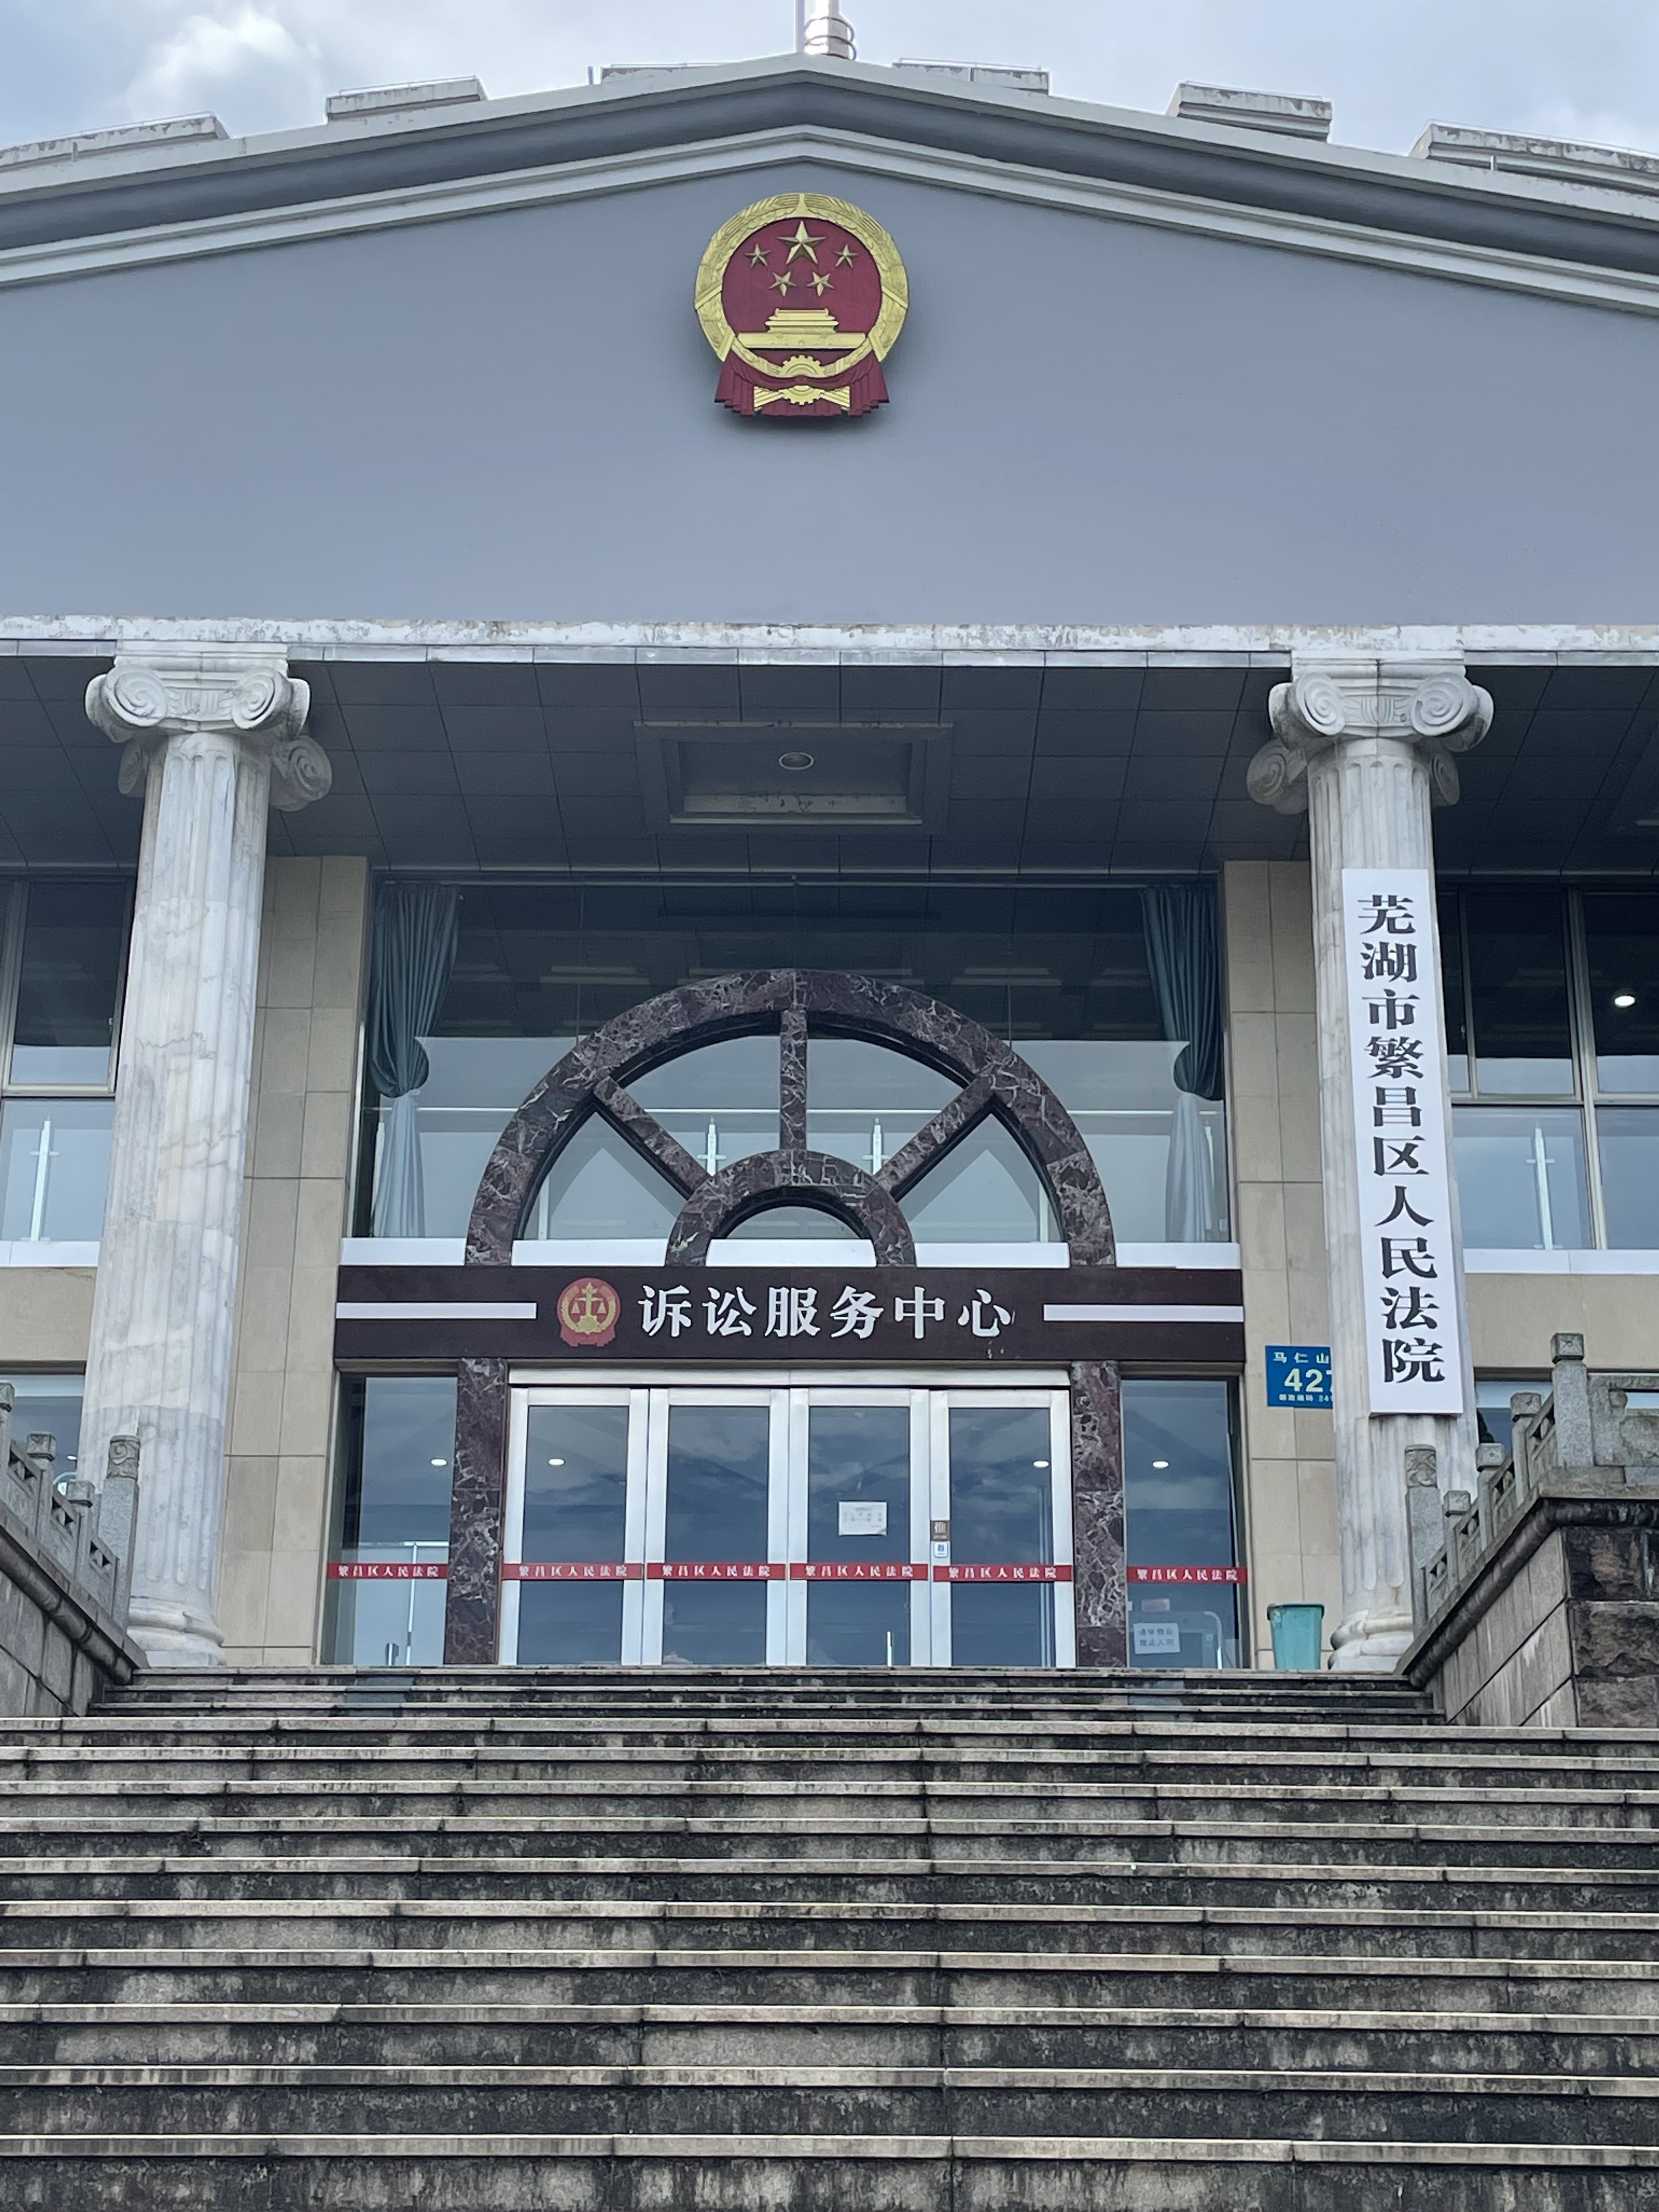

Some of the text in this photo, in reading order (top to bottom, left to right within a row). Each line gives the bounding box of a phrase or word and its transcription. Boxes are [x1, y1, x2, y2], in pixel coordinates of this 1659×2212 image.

[1357, 894, 1446, 1383] 芜湖市繁昌区人民法院
[637, 1285, 1011, 1339] 诉讼服务中心
[1273, 1352, 1329, 1364] 马仁山
